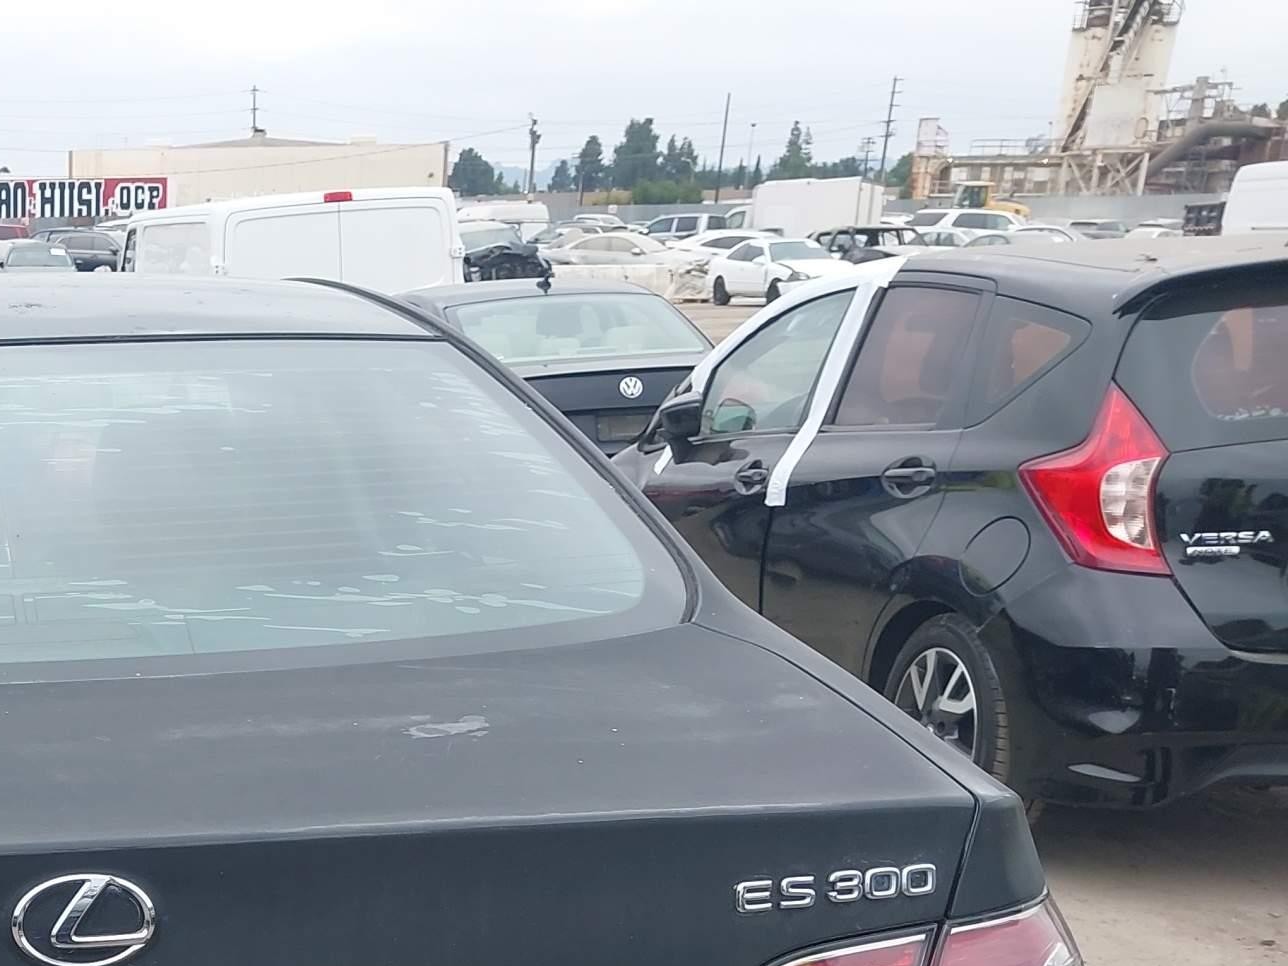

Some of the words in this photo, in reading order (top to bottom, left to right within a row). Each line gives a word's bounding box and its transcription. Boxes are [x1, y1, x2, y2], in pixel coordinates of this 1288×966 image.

[118, 185, 161, 211] OCP
[1179, 531, 1275, 545] VERSA
[735, 875, 816, 914] ES
[827, 863, 937, 903] 300
